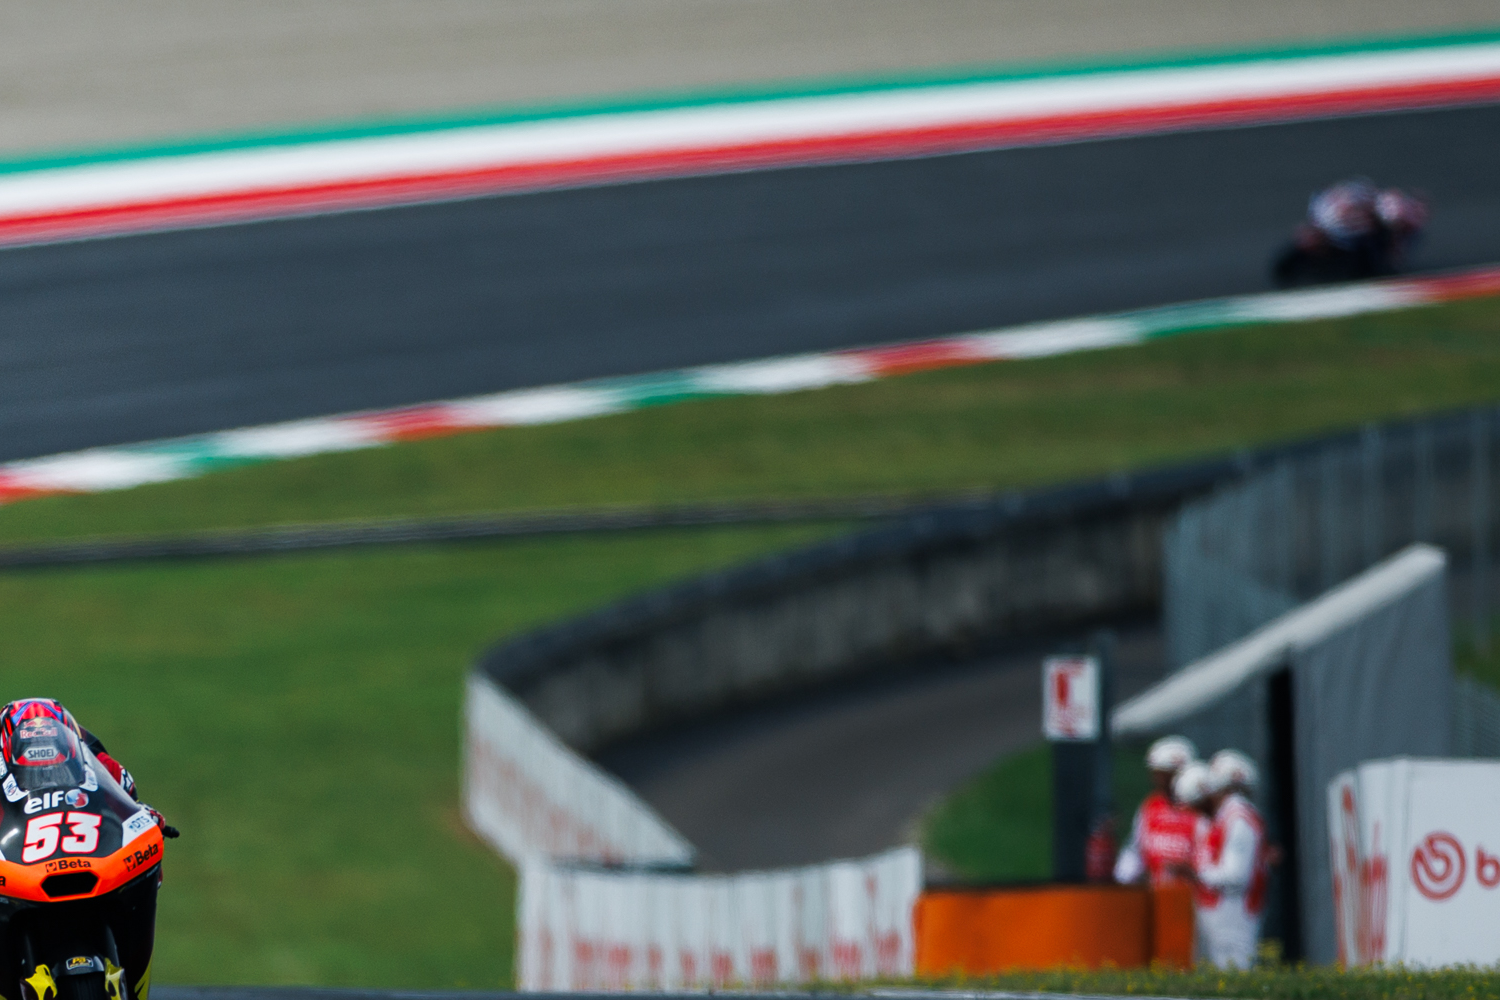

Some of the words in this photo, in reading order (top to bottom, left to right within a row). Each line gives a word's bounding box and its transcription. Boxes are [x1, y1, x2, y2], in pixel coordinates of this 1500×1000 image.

[27, 748, 54, 759] SHOEI
[24, 791, 64, 814] elf
[22, 811, 102, 863] 53
[58, 859, 92, 870] Beta
[135, 844, 159, 867] Beta
